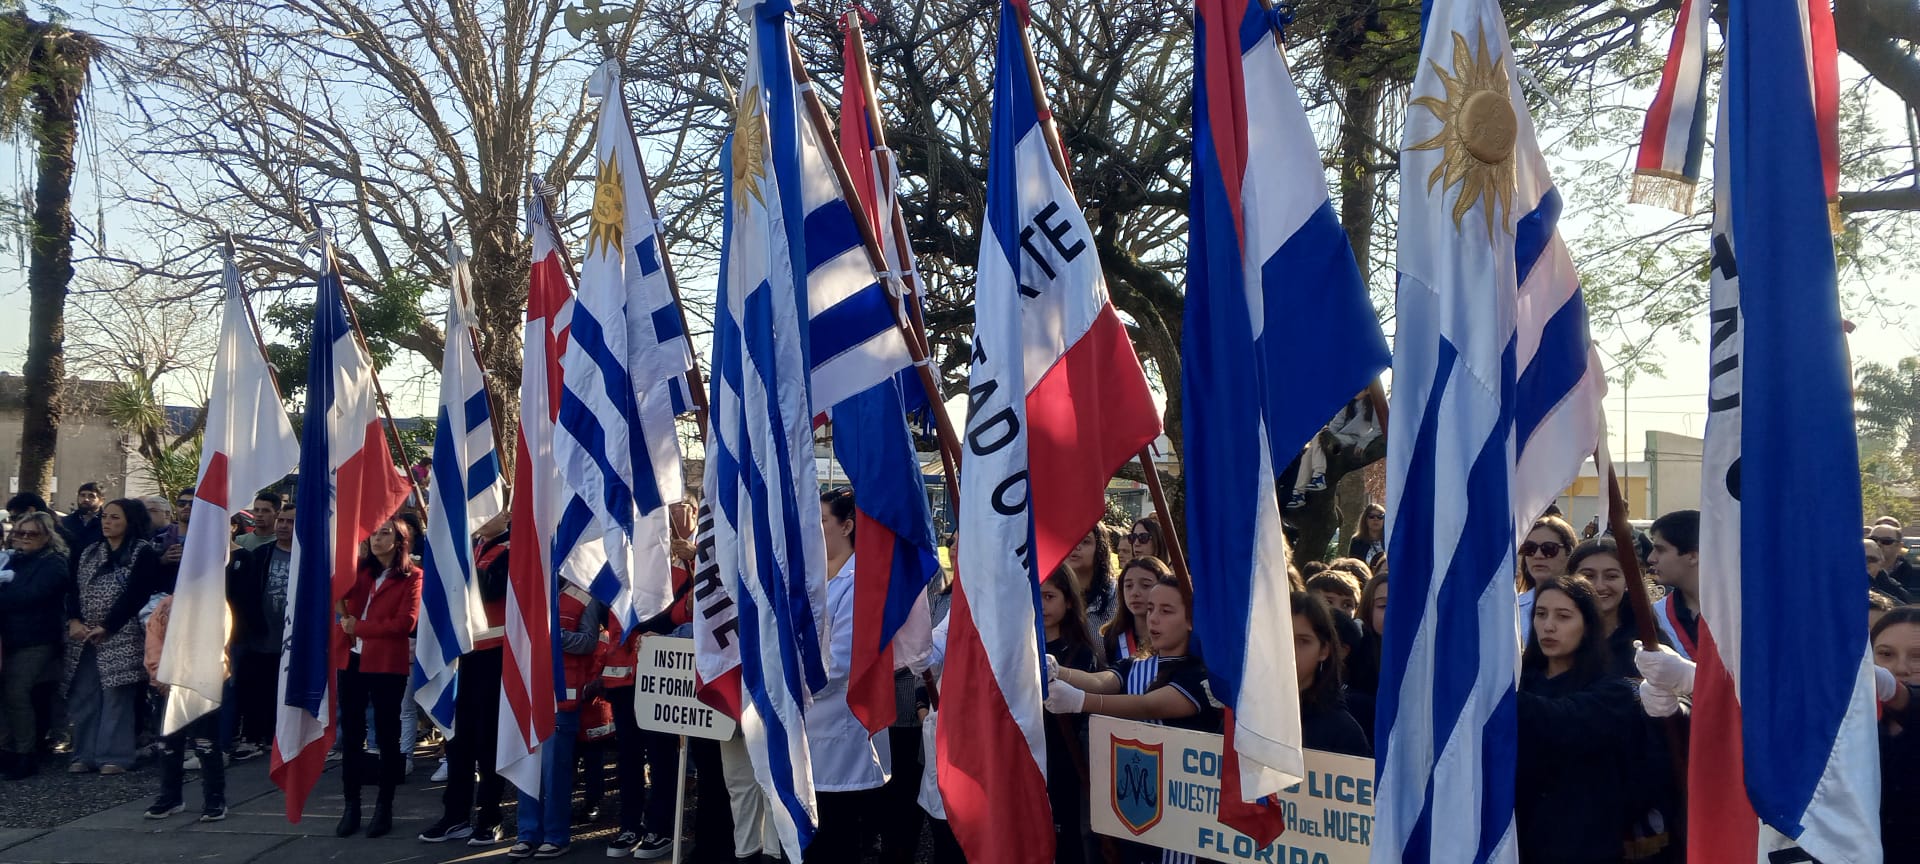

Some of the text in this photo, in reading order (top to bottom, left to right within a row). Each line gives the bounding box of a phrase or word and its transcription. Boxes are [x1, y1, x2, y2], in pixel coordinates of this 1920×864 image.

[654, 649, 696, 671] INSTIT
[641, 675, 656, 694] DE
[654, 703, 713, 728] DOCENTE
[1308, 770, 1372, 806] LICE
[1168, 779, 1221, 815] NUESTR
[1300, 818, 1322, 837] DEL
[1323, 807, 1375, 847] HUER
